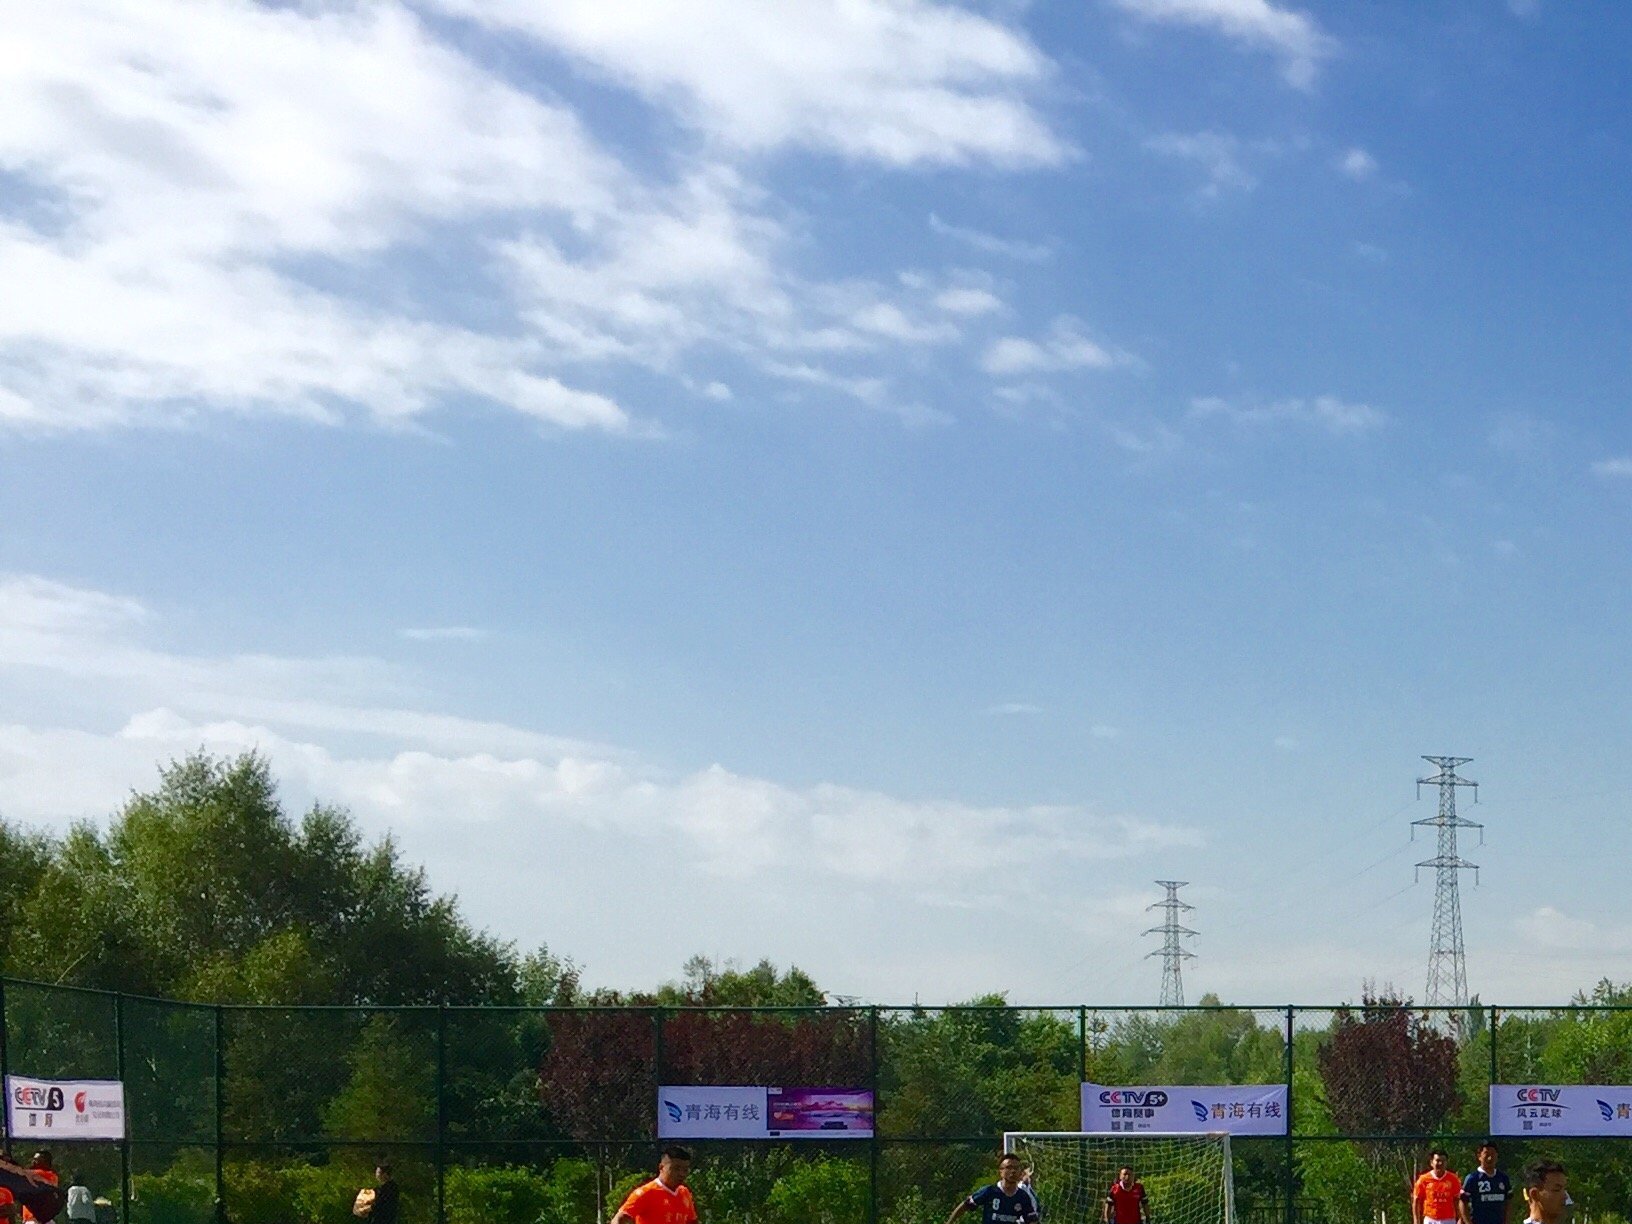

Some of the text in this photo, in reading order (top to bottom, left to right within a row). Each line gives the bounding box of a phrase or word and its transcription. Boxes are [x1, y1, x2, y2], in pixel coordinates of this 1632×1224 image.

[1517, 1089, 1561, 1101] CCTV
[685, 1103, 760, 1121] 青海有线
[1211, 1102, 1281, 1119] 青海有线
[1517, 1108, 1561, 1118] 风云足球
[1478, 1180, 1491, 1192] 23
